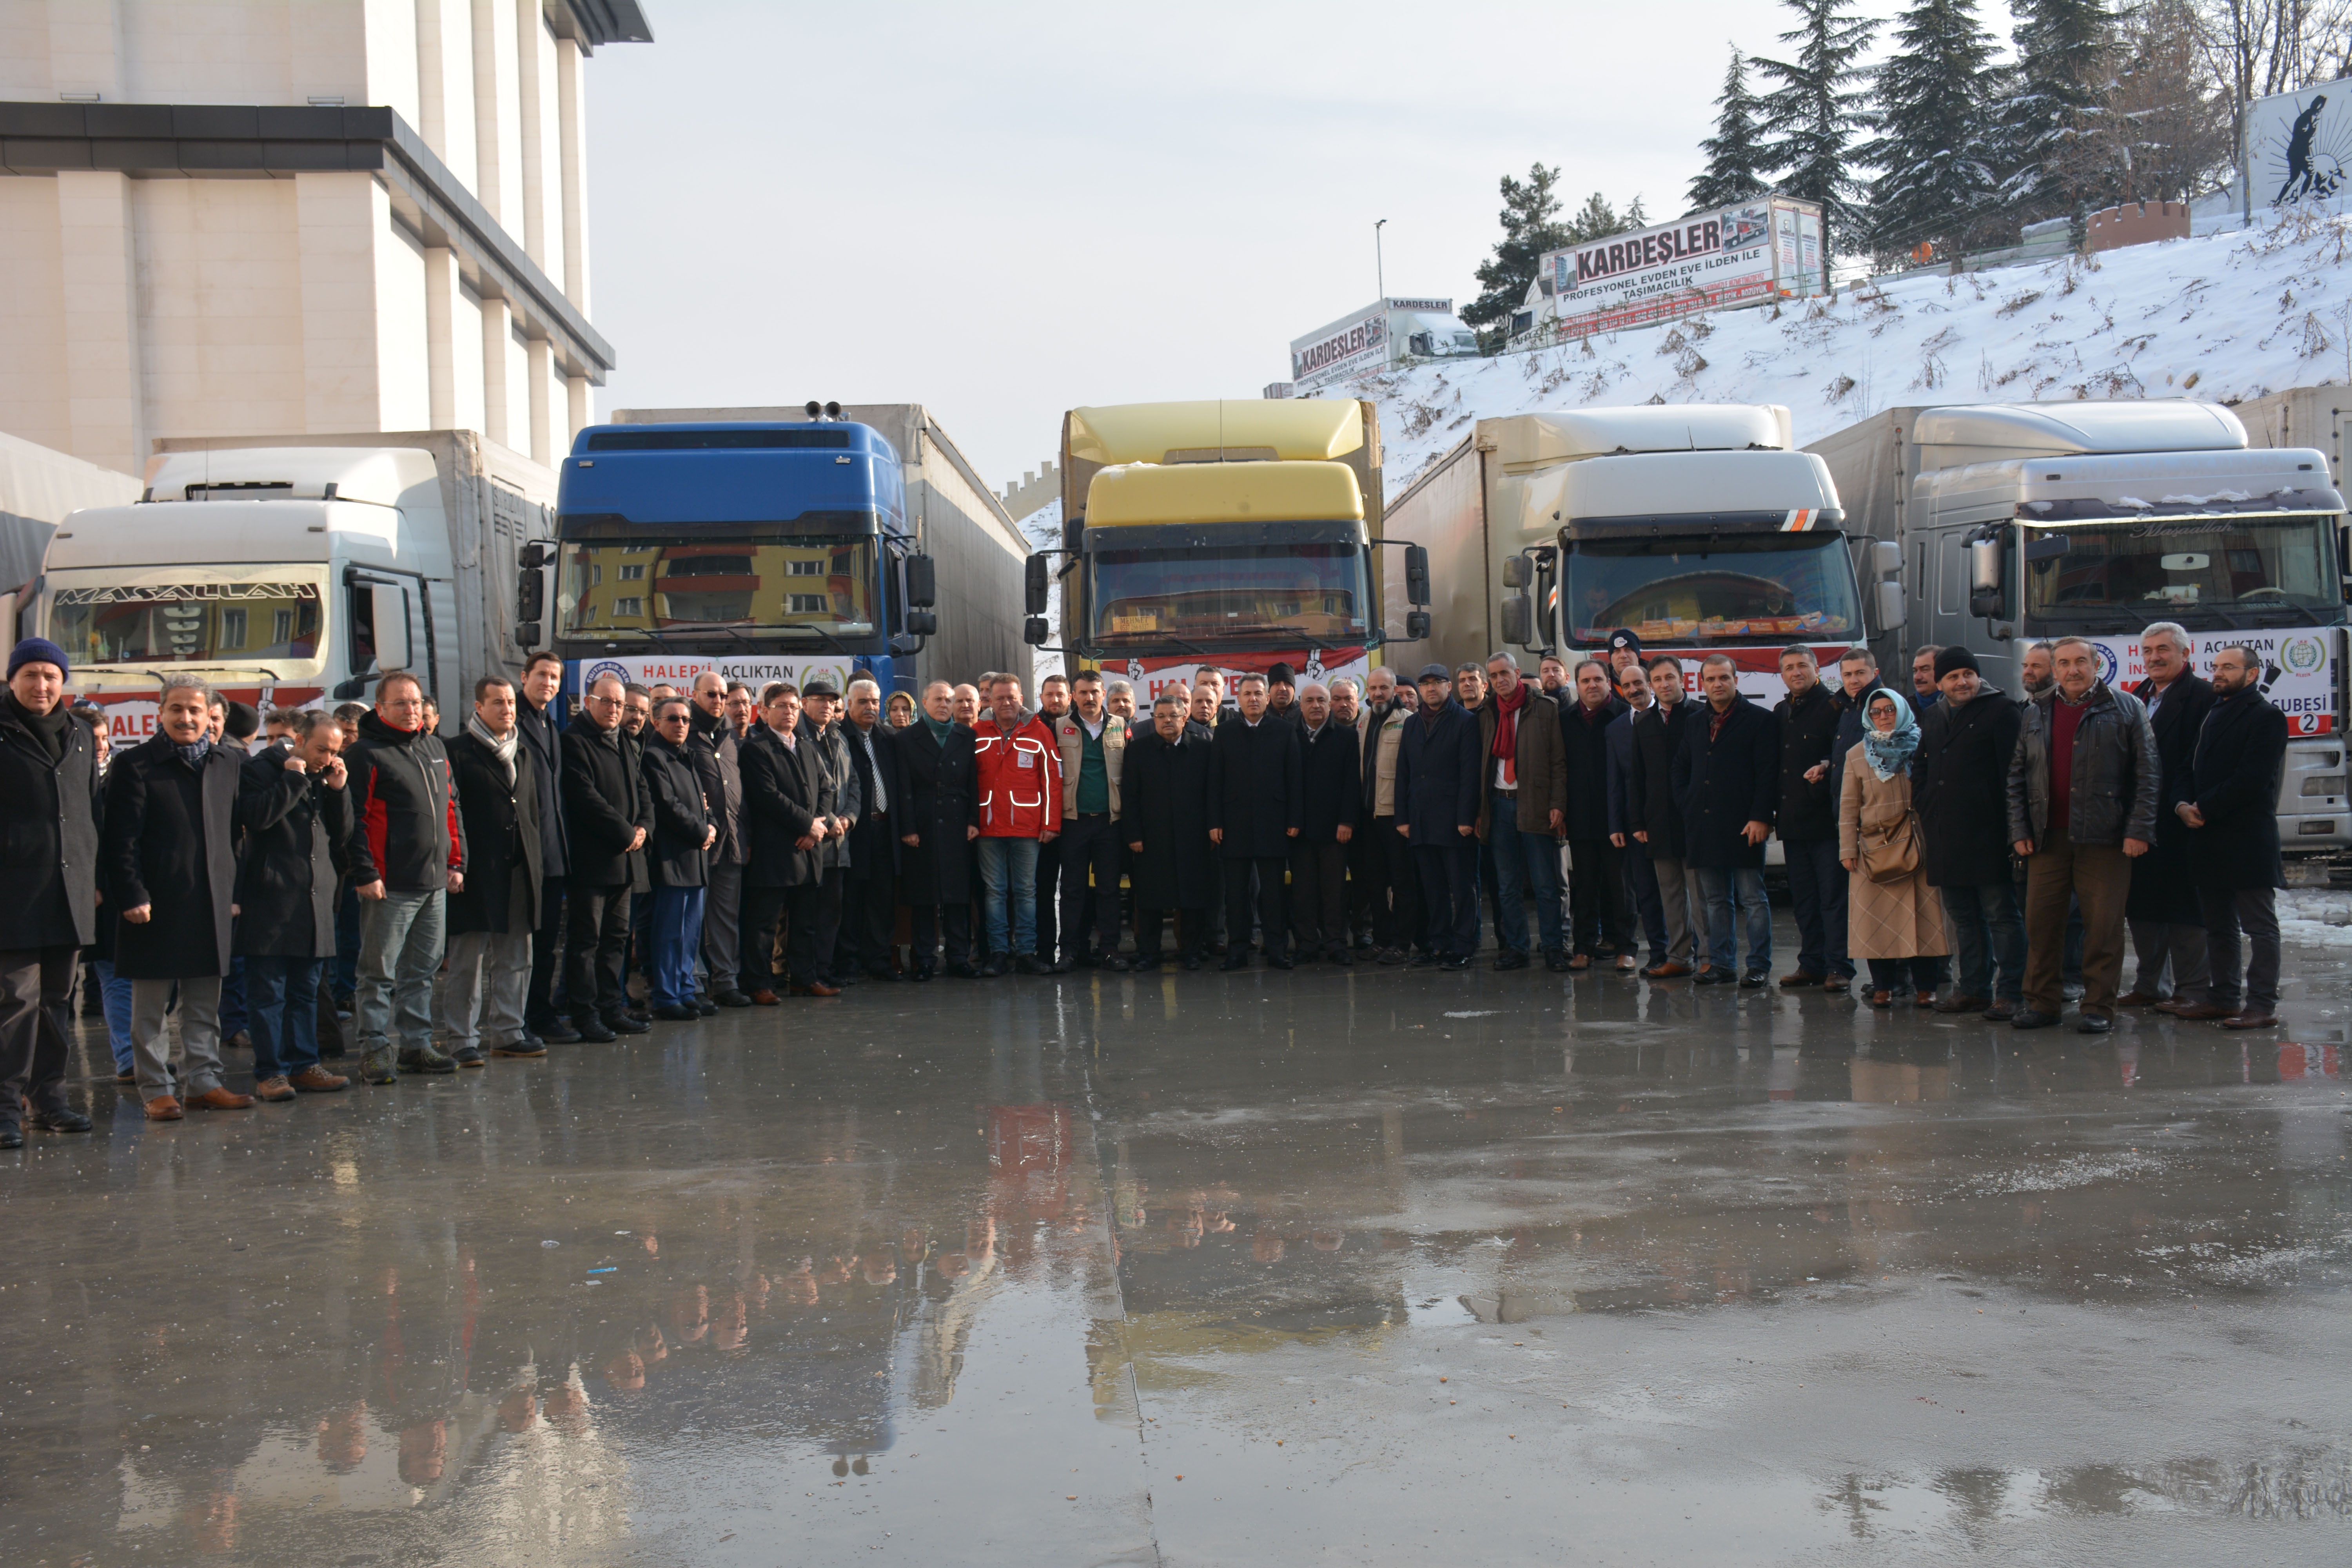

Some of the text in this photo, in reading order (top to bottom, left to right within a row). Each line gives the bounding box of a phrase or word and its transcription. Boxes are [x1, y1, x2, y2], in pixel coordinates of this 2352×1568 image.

[1578, 221, 1720, 280] KARDEŞLER
[1563, 249, 1760, 302] PROFESYONEL EVDEN EVE İLDEN İLE
[1623, 276, 1693, 299] TAŞIMACILIK
[1716, 290, 1737, 303] BİLECİK
[1741, 283, 1767, 297] BOZÜYÜK
[1393, 300, 1447, 309] KARDEŞLER
[1303, 326, 1365, 372] KARDEŞLER
[1298, 370, 1330, 388] PROFESYONEL
[1331, 364, 1347, 374] EVDEN
[1349, 359, 1359, 368] EVE
[1359, 352, 1374, 362] İLDEN
[1375, 345, 1384, 356] İLE
[1325, 366, 1356, 385] TAŞIMACILIK
[56, 583, 316, 606] MASALLAH
[643, 662, 793, 681] HALEP'İ AÇLIKTAN
[107, 715, 161, 737] ALE
[2303, 714, 2314, 731] 2
